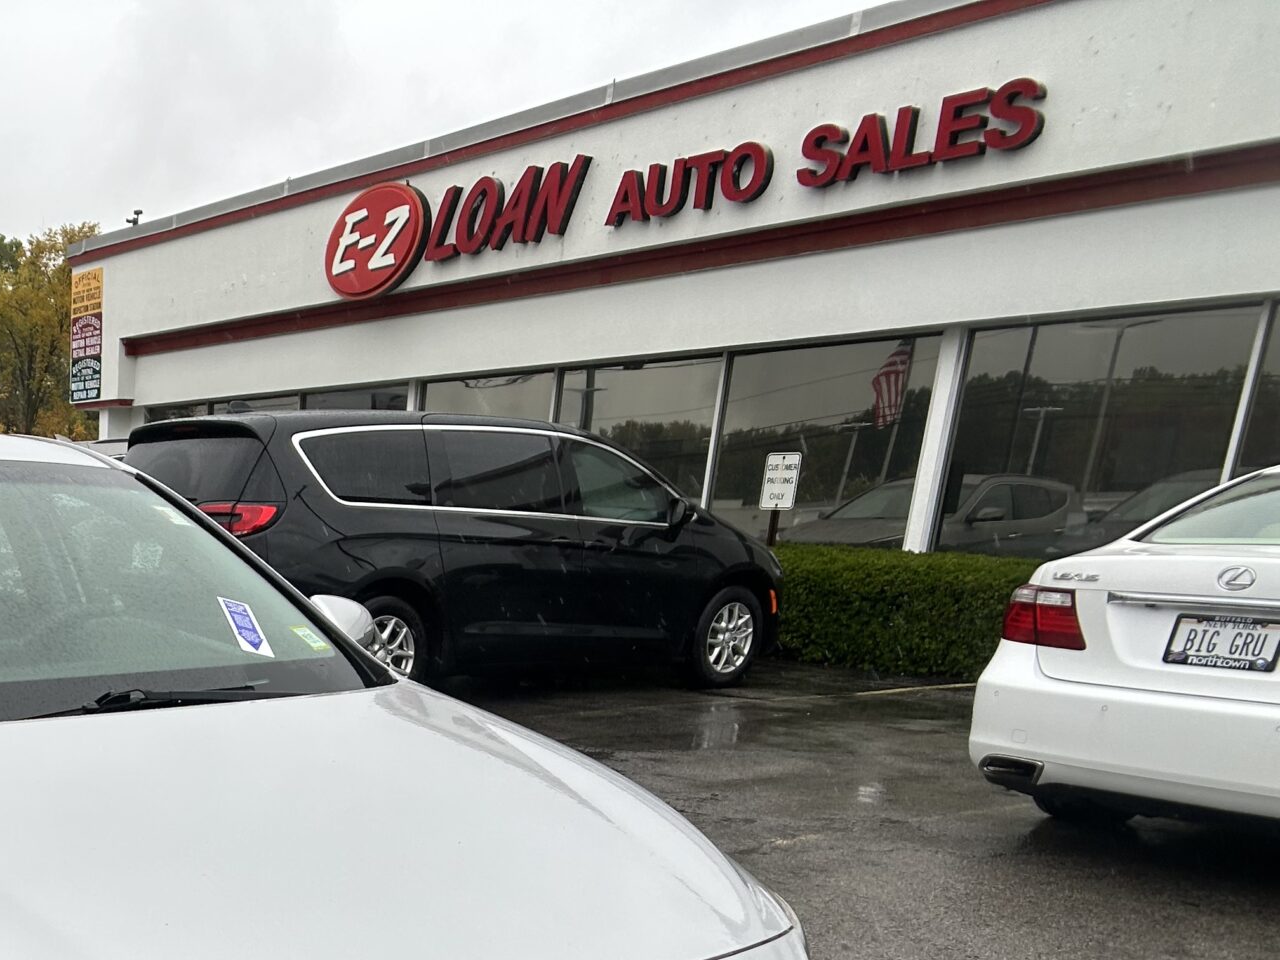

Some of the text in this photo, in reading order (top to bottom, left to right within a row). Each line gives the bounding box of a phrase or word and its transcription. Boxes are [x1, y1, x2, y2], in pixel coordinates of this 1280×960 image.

[424, 77, 1048, 262] LOAN AUTO SALES
[332, 204, 410, 276] E-Z
[74, 272, 100, 289] OFFICIAL
[73, 315, 101, 335] REGISTERED
[73, 358, 101, 375] REGISTERED
[1053, 571, 1100, 582] LEXUS
[1204, 621, 1261, 631] NEW YORK
[1214, 616, 1254, 624] BUFFALO
[1183, 628, 1269, 657] BIG GRU
[1187, 655, 1250, 669] northtown
